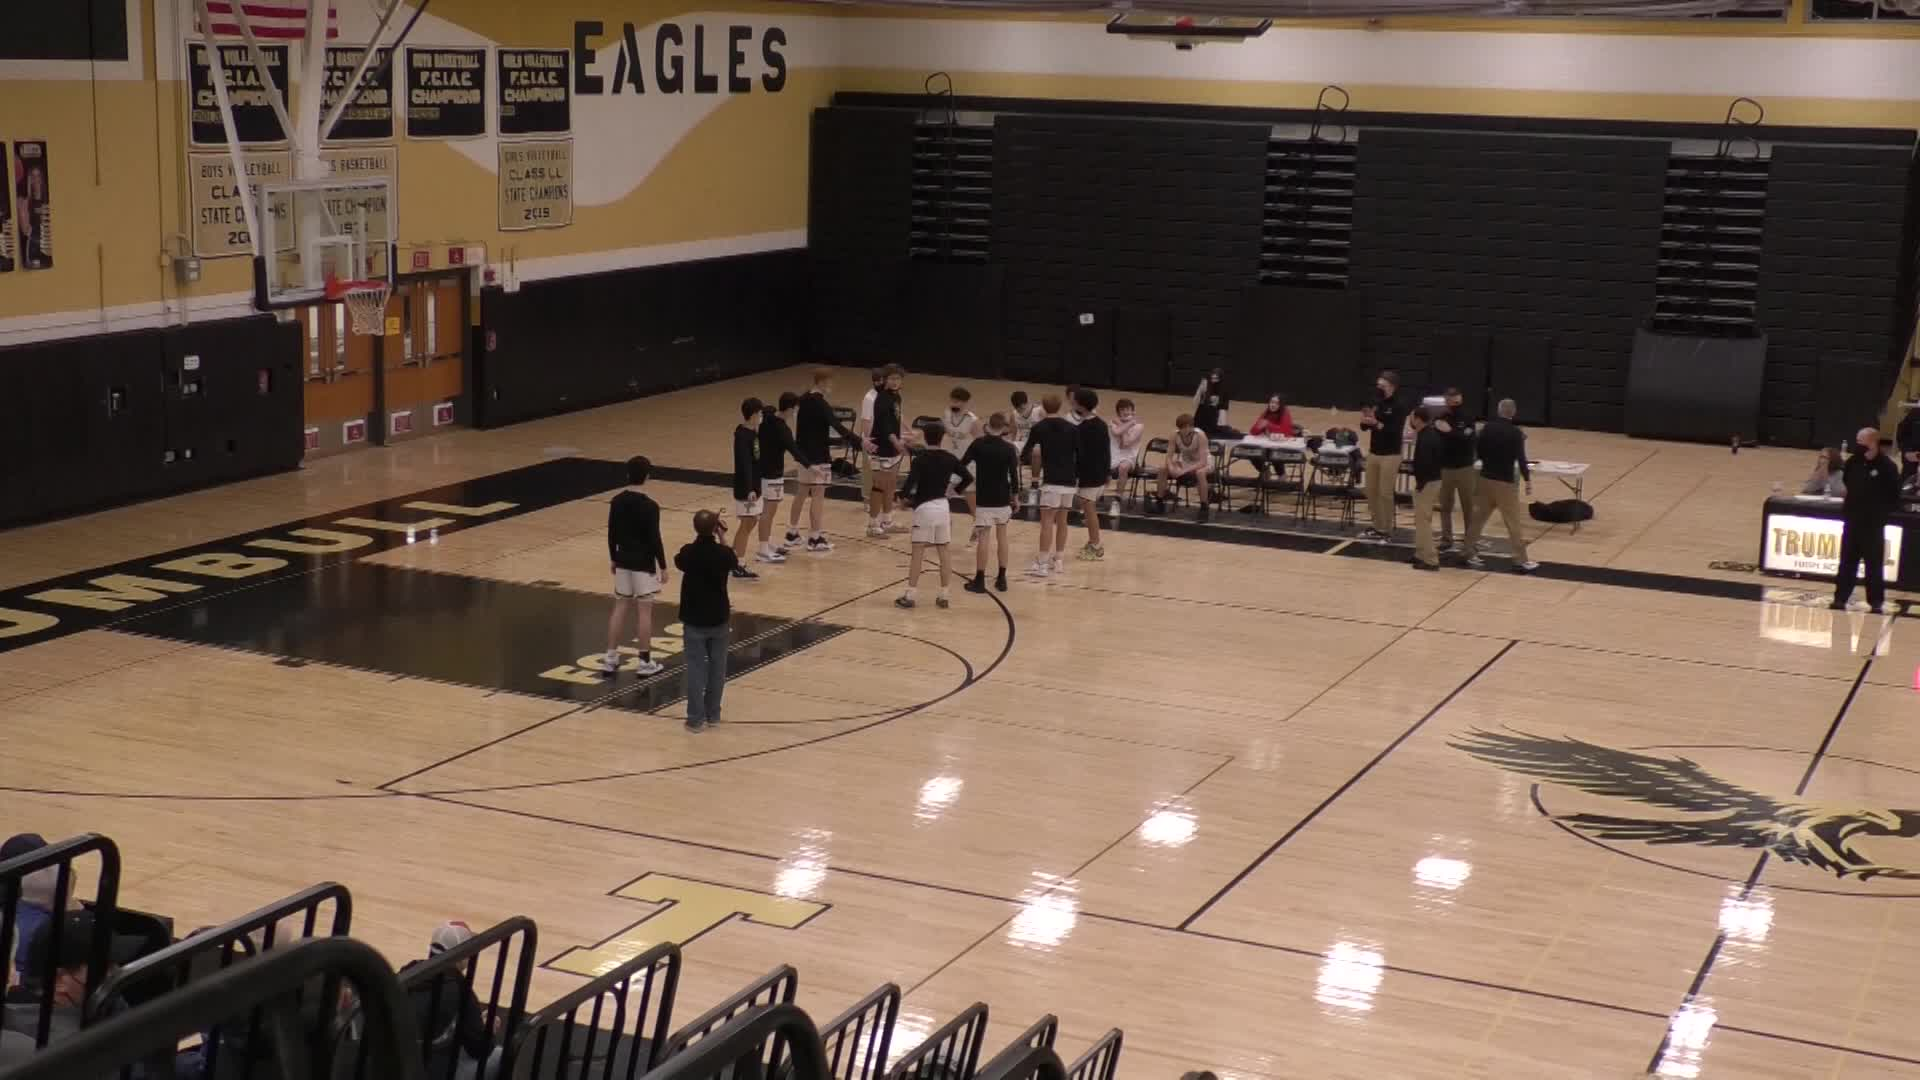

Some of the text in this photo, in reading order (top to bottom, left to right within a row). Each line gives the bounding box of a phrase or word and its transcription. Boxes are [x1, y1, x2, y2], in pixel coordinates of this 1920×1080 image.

[574, 21, 787, 94] EAGLES
[411, 89, 481, 104] CHAMPIONS
[503, 87, 565, 102] CHAMPIONS
[201, 161, 281, 178] BOYS VLEYBALL
[509, 166, 563, 180] CLASS LL
[504, 184, 568, 203] STATE CHAMPIONS
[201, 206, 231, 224] STATE
